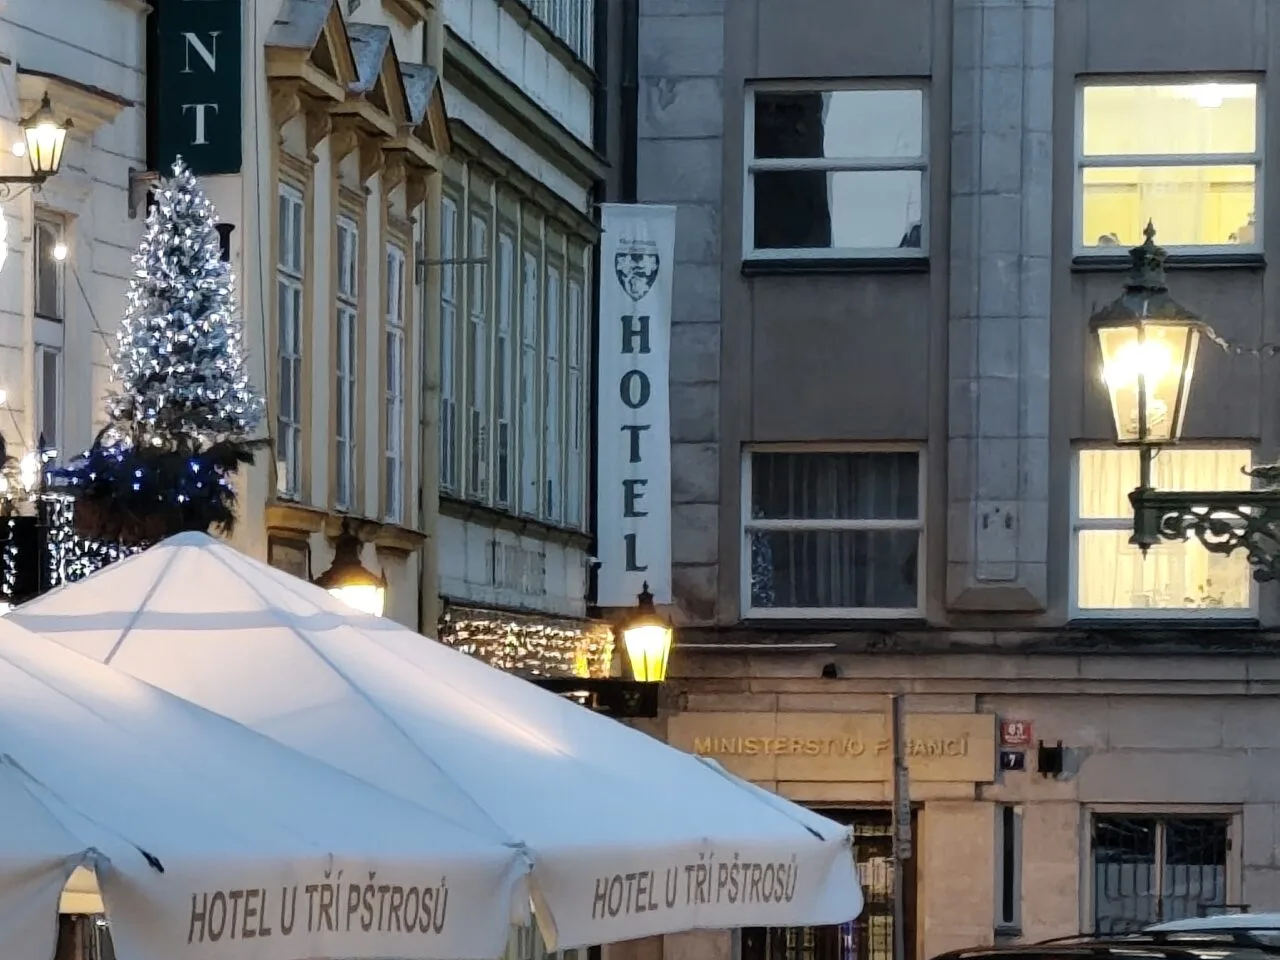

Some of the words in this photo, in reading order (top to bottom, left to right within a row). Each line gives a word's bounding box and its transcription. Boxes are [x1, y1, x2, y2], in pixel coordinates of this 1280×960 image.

[179, 0, 222, 145] NT
[620, 315, 651, 572] HOTEL
[693, 735, 866, 757] MINISTERSTVO
[187, 887, 272, 944] HOTEL
[280, 885, 298, 936] U
[305, 869, 344, 932] TŘÍ
[592, 870, 658, 920] HOTEL
[665, 866, 679, 909] U
[684, 852, 715, 905] TŘÍ
